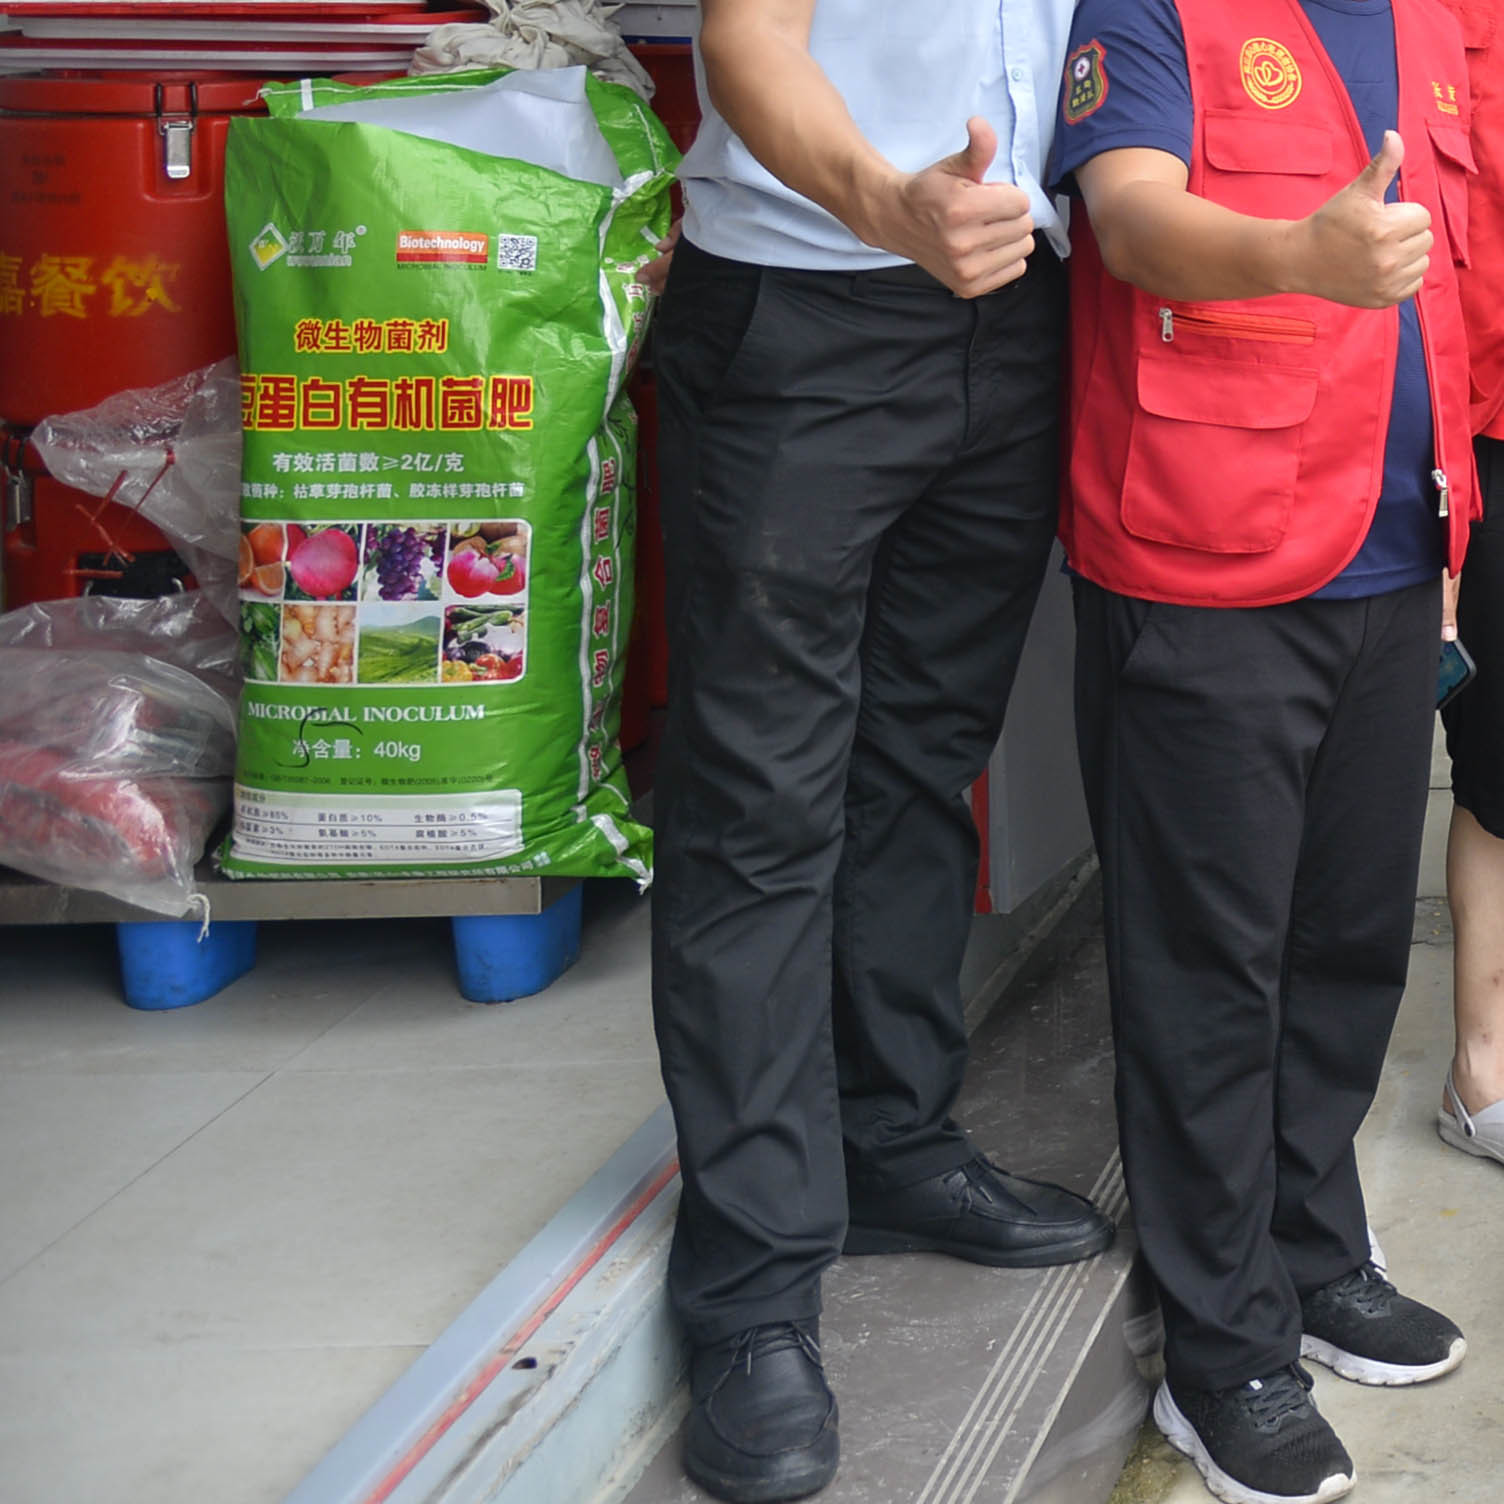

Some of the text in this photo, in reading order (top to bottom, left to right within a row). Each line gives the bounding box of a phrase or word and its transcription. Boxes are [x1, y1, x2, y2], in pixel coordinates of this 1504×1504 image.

[400, 235, 484, 253] Biotechnology
[295, 319, 448, 353] 微生物菌剂
[248, 701, 486, 722] MICROBIAL INOCULUM
